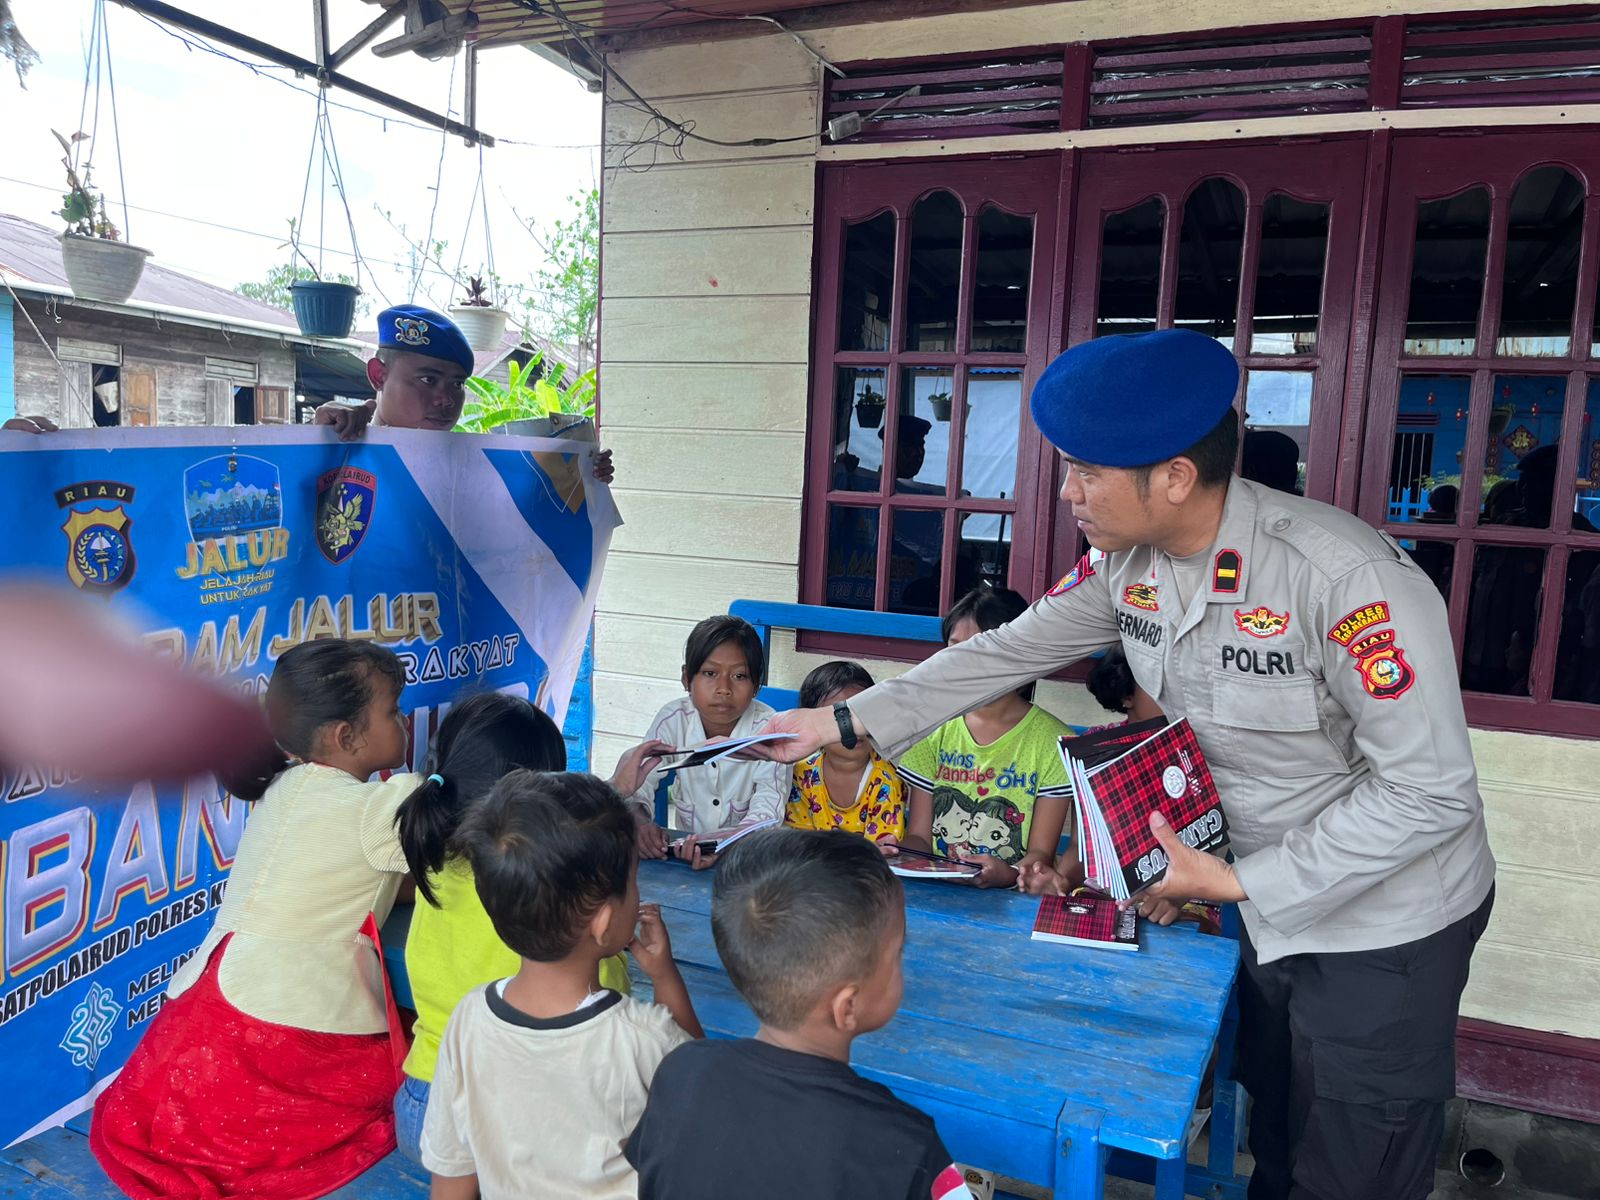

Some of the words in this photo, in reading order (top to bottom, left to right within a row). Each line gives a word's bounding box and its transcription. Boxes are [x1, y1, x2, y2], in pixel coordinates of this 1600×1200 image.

[64, 485, 127, 502] RIAU
[175, 528, 290, 579] JALUR
[200, 573, 254, 590] JELAJAH
[200, 590, 241, 606] UNTUK
[267, 592, 444, 660] JALUR
[1332, 604, 1385, 639] POLRES
[1352, 632, 1390, 654] RIAU
[398, 634, 520, 686] RAKYAT
[1221, 644, 1296, 676] POLRI
[133, 888, 210, 949] POLRES
